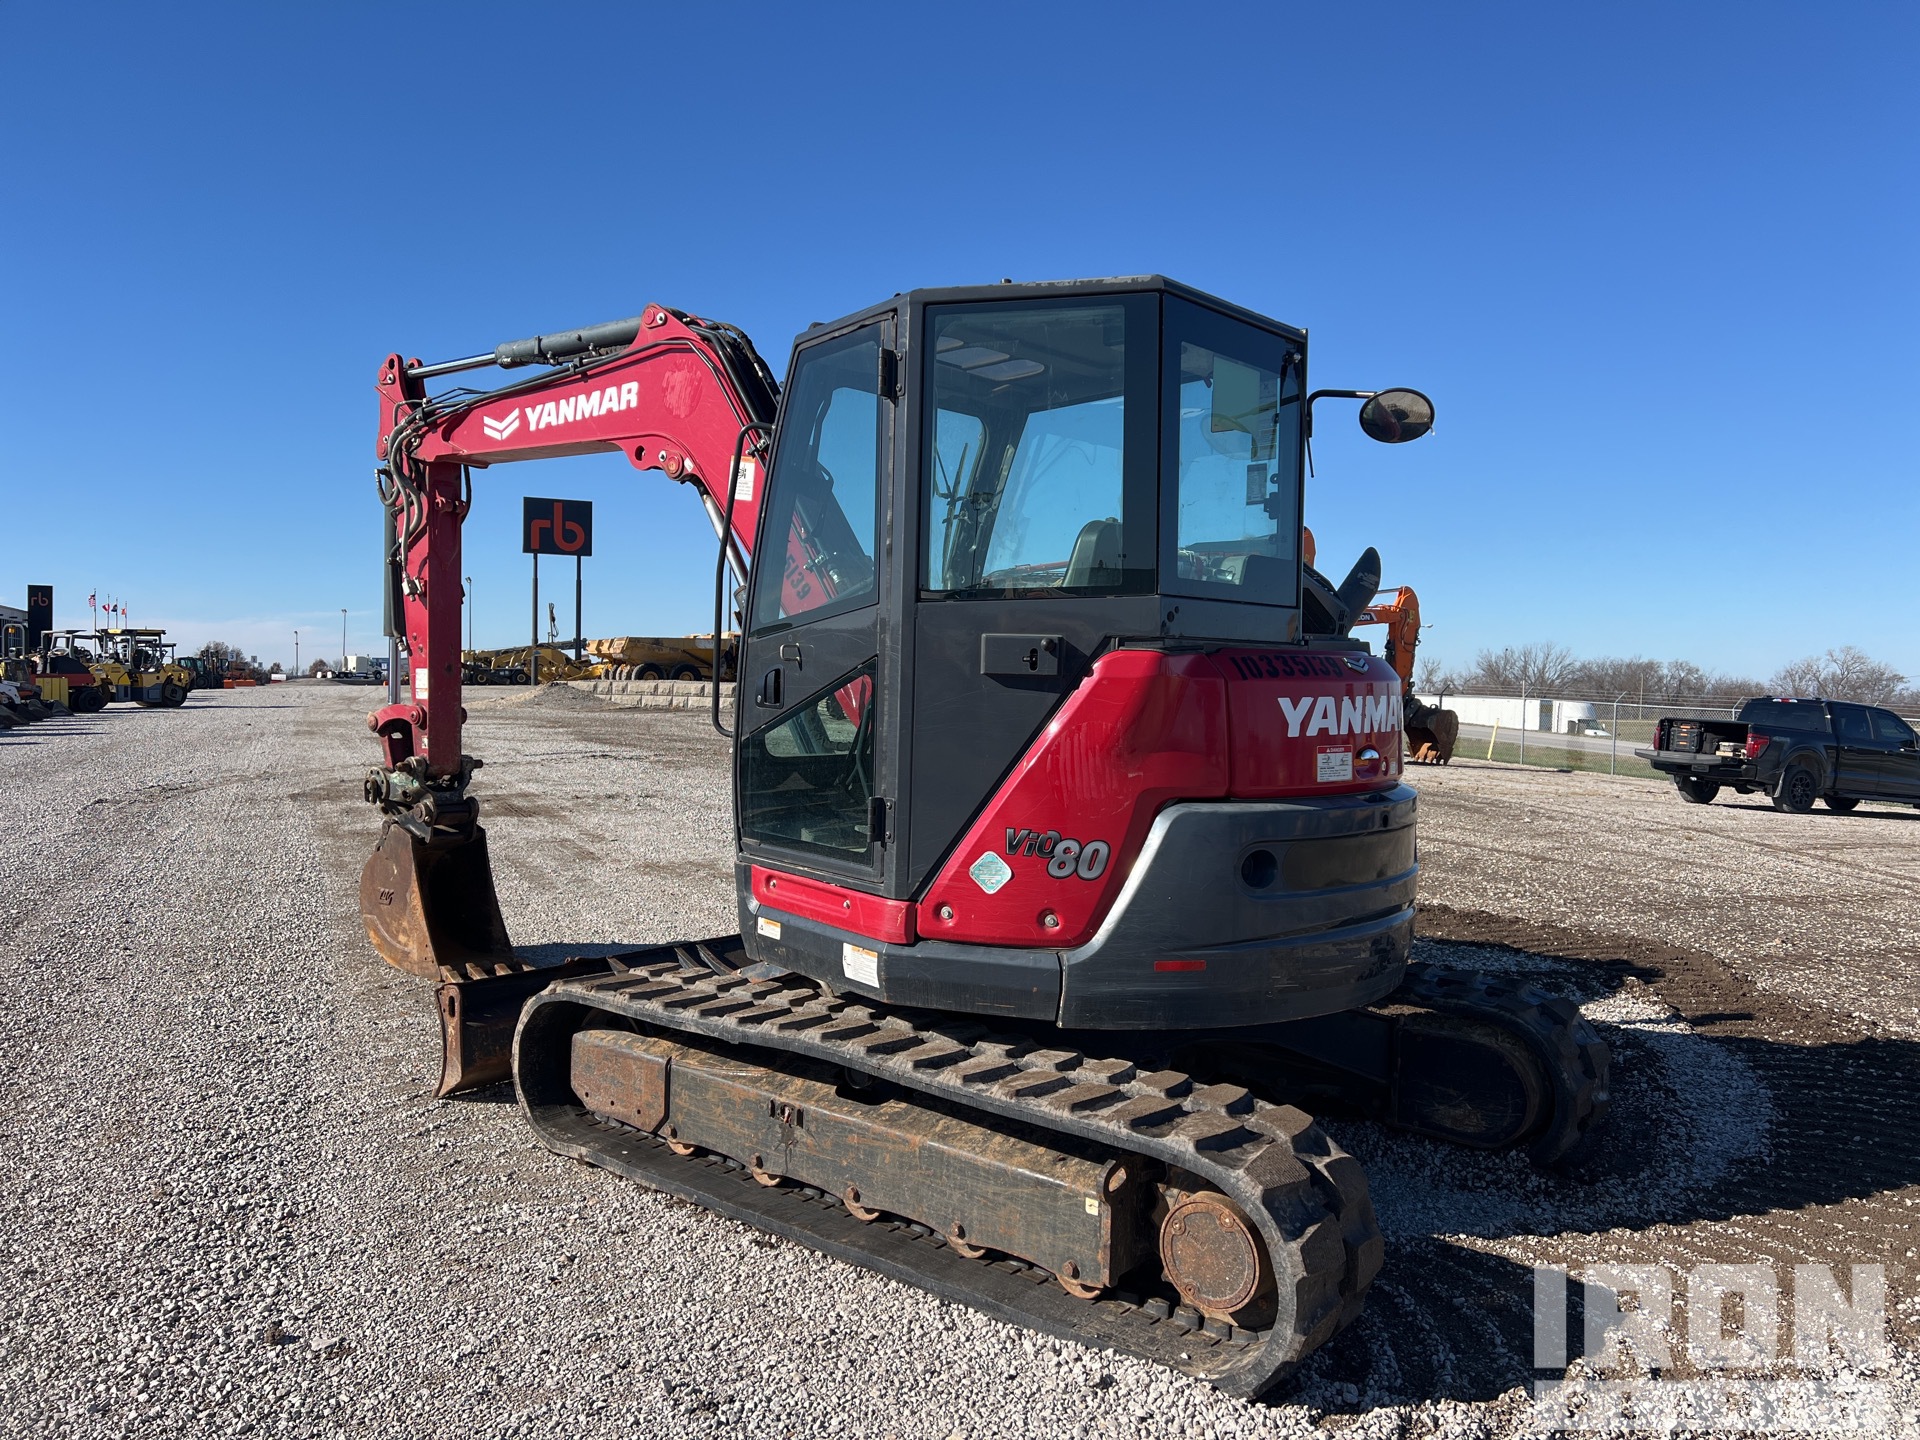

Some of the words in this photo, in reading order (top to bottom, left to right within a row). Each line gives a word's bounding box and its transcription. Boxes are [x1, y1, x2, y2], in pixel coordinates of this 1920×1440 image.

[524, 381, 639, 432] YANMAR
[530, 502, 586, 551] rb
[31, 592, 49, 607] rb
[1229, 655, 1344, 681] 10335139
[1047, 838, 1111, 881] 80
